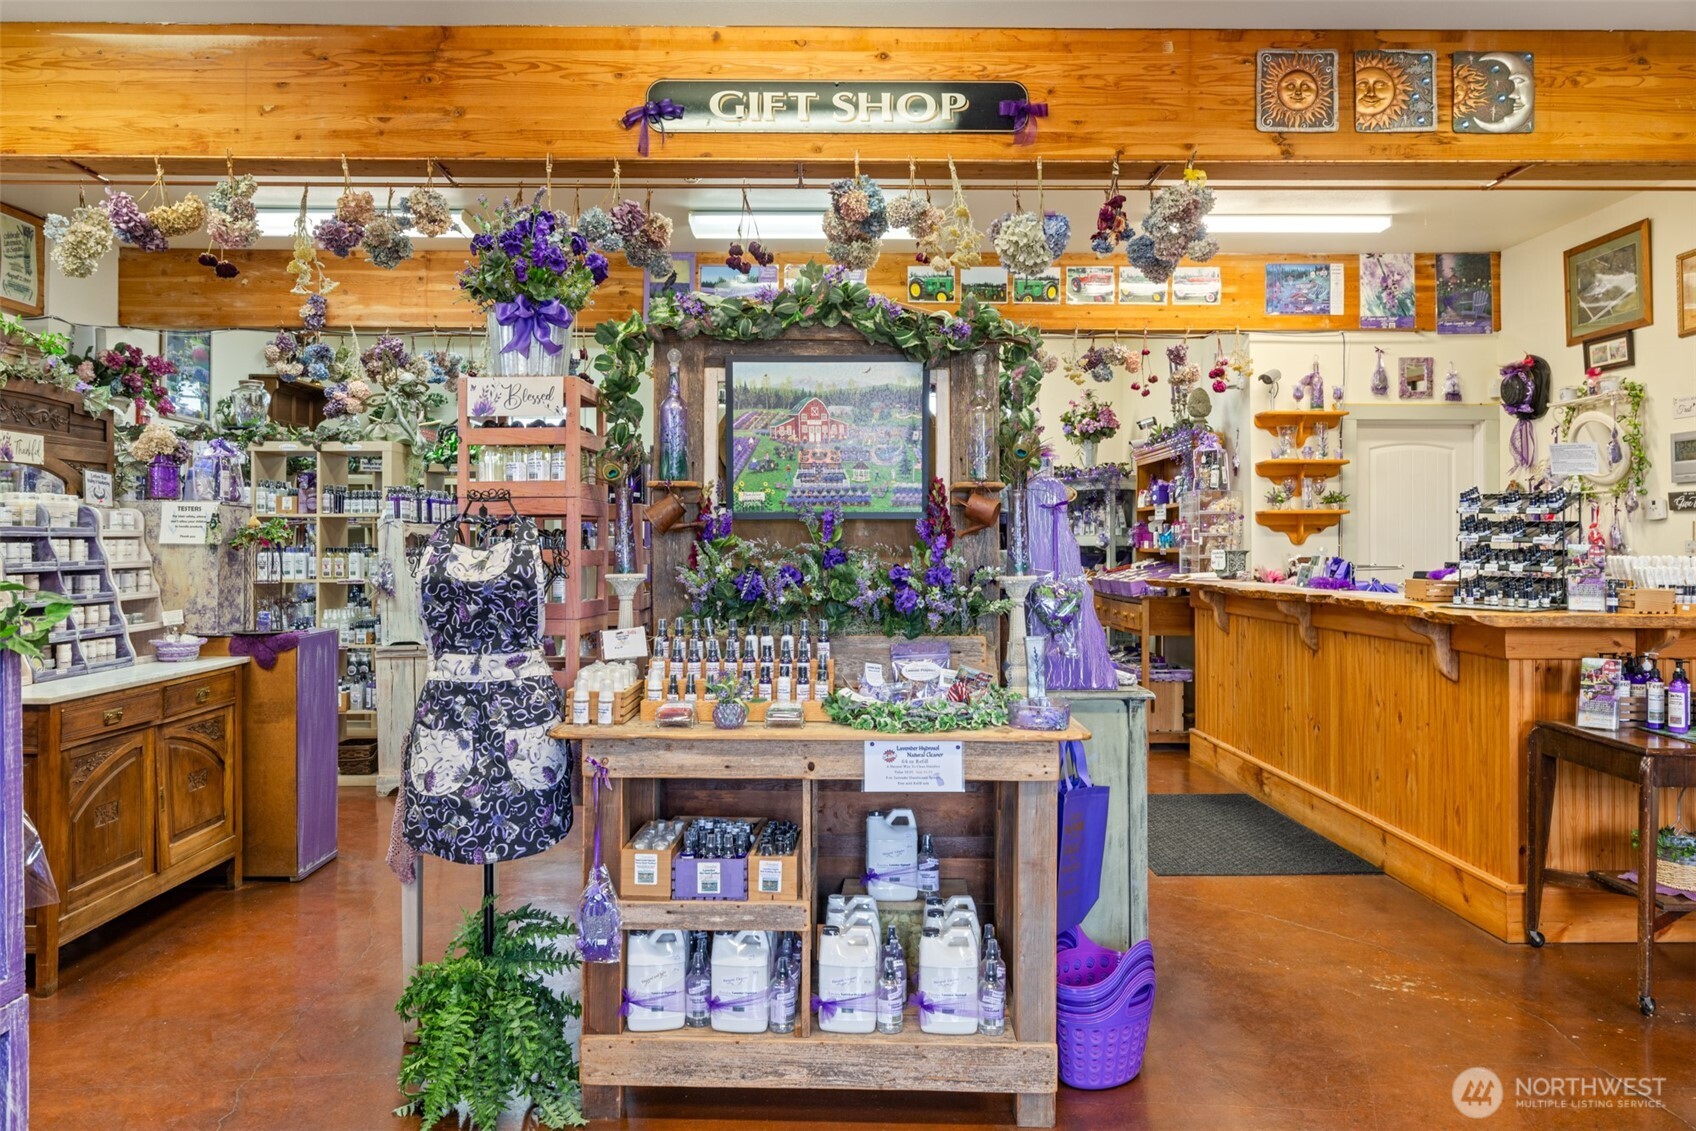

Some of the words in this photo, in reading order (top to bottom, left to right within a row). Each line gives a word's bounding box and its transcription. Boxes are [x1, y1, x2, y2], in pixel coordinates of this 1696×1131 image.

[709, 90, 820, 123] GIFT
[832, 91, 970, 123] SHOP
[500, 382, 556, 411] Blessed
